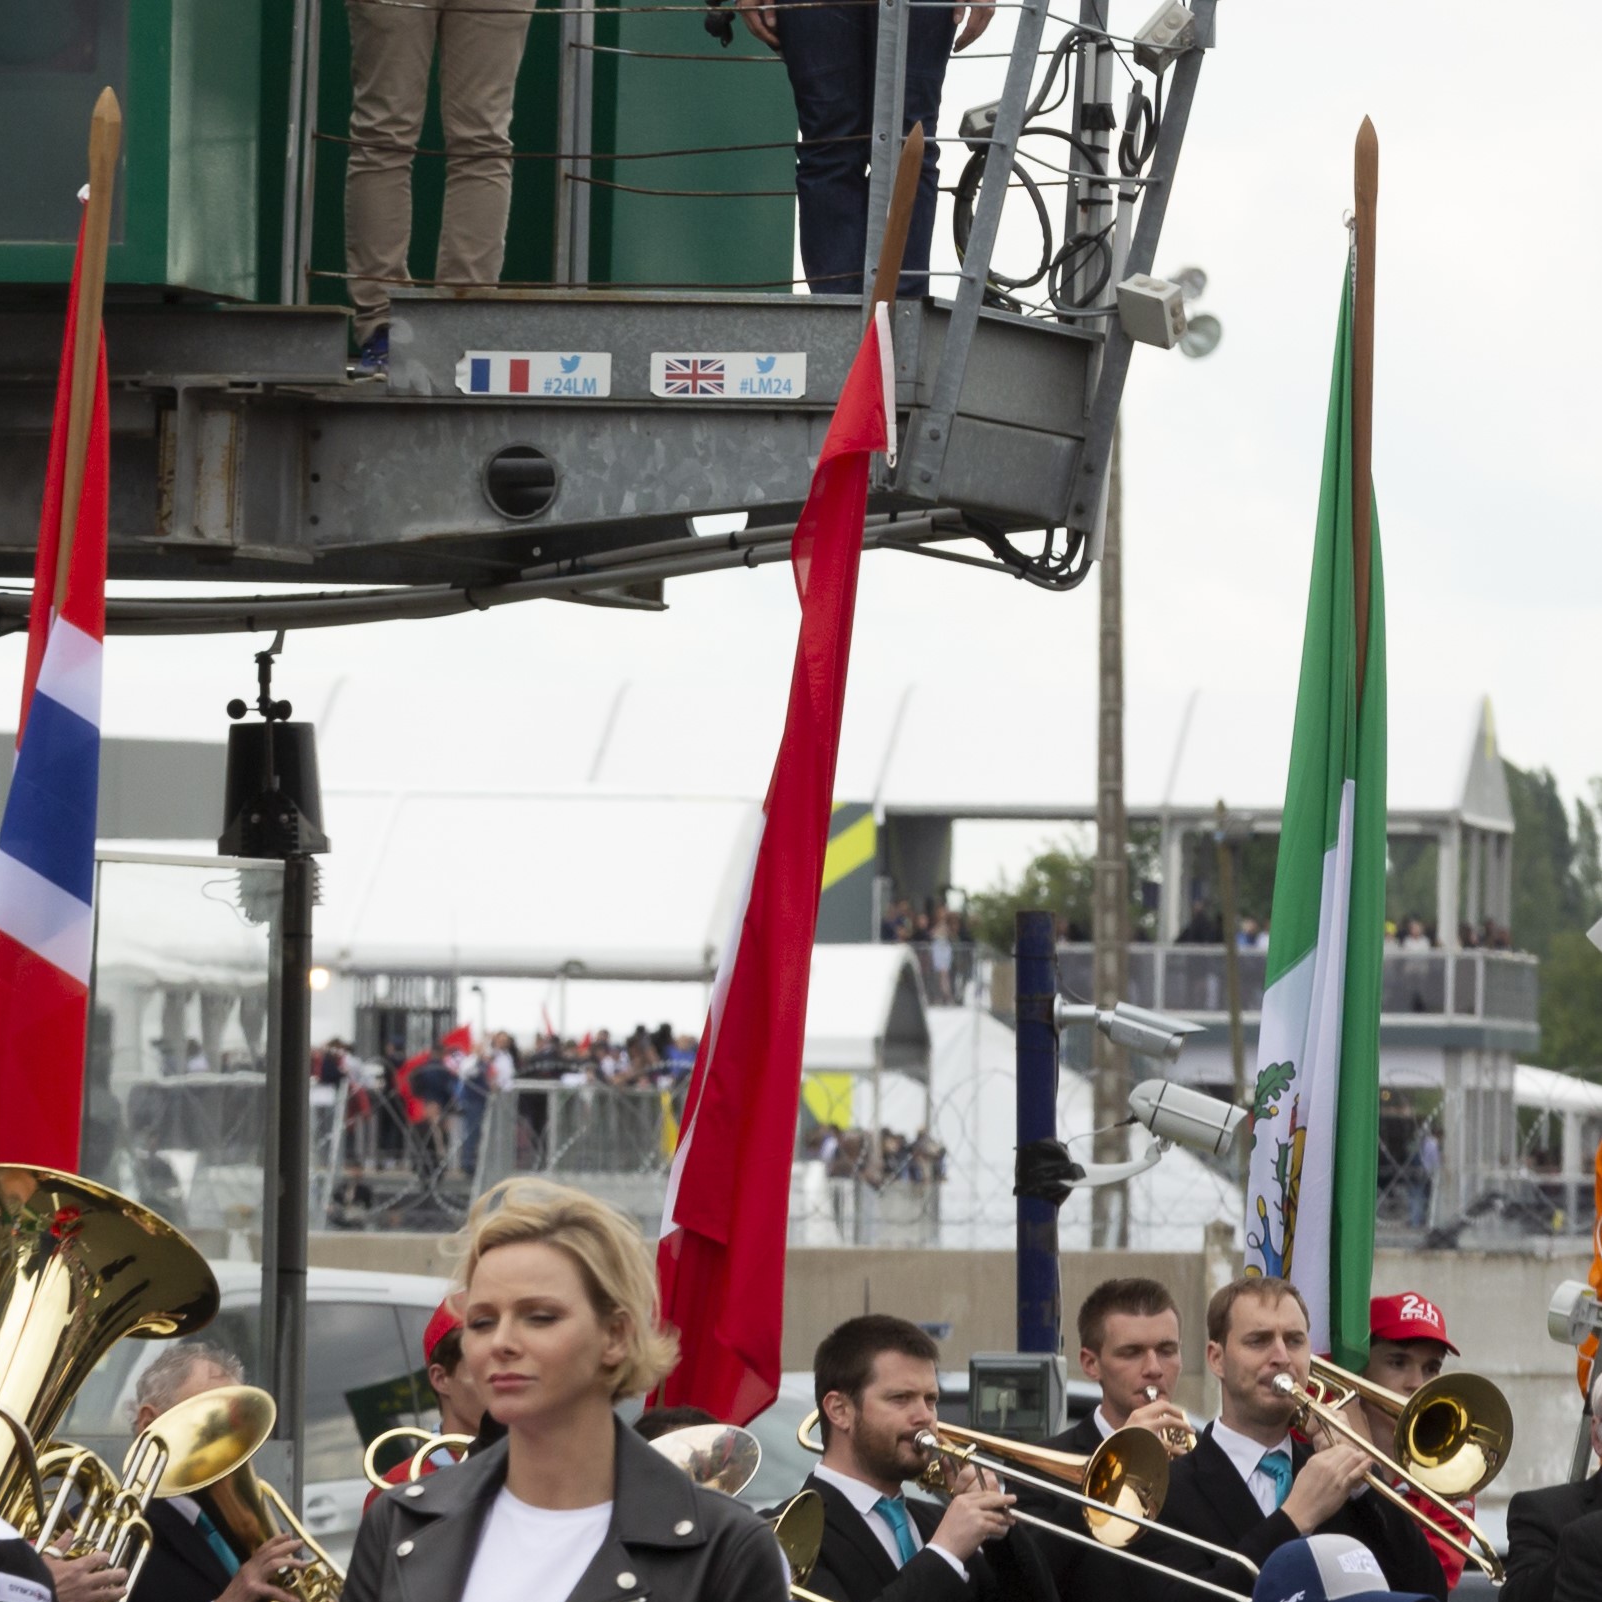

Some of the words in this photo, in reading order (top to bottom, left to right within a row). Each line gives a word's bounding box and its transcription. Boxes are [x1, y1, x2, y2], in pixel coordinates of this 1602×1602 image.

[543, 377, 597, 395] #24LM
[740, 377, 793, 395] #LM24
[1401, 1294, 1439, 1323] 24h
